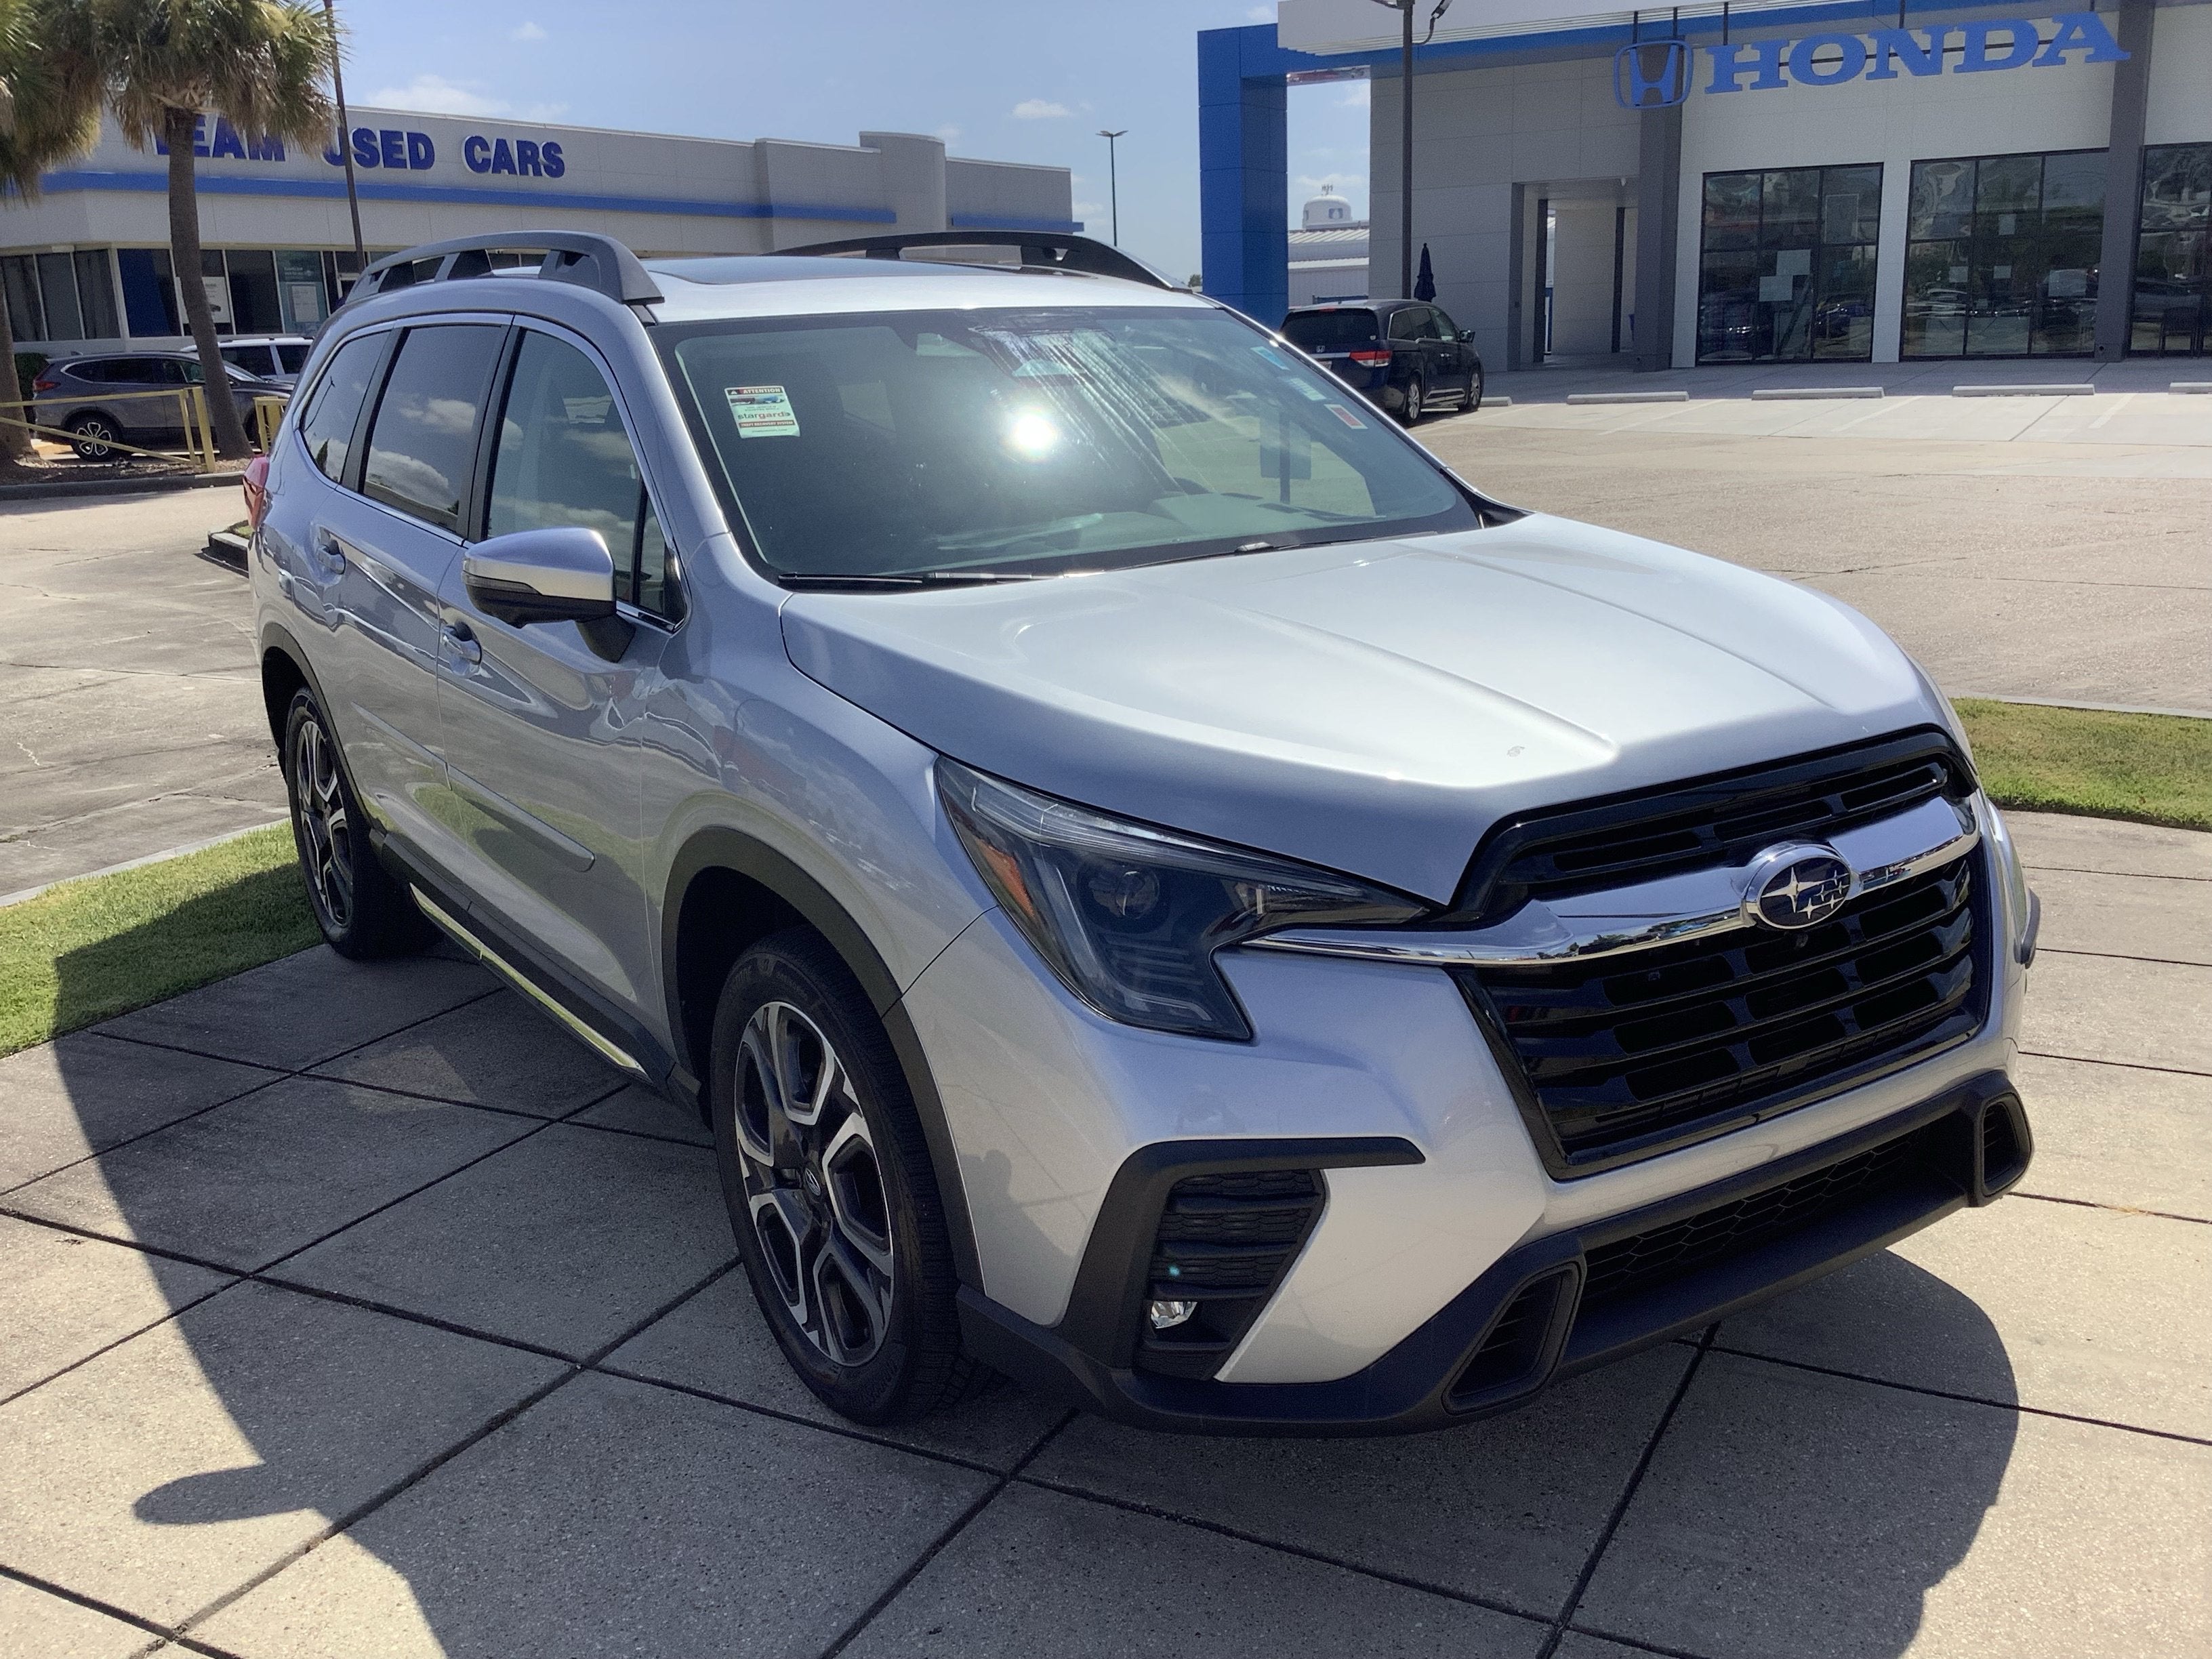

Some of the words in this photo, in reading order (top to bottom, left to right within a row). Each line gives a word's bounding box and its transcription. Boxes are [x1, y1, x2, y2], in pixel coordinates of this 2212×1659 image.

[1704, 11, 2133, 94] HONDA
[150, 112, 286, 162] EAM
[463, 135, 565, 178] CARS
